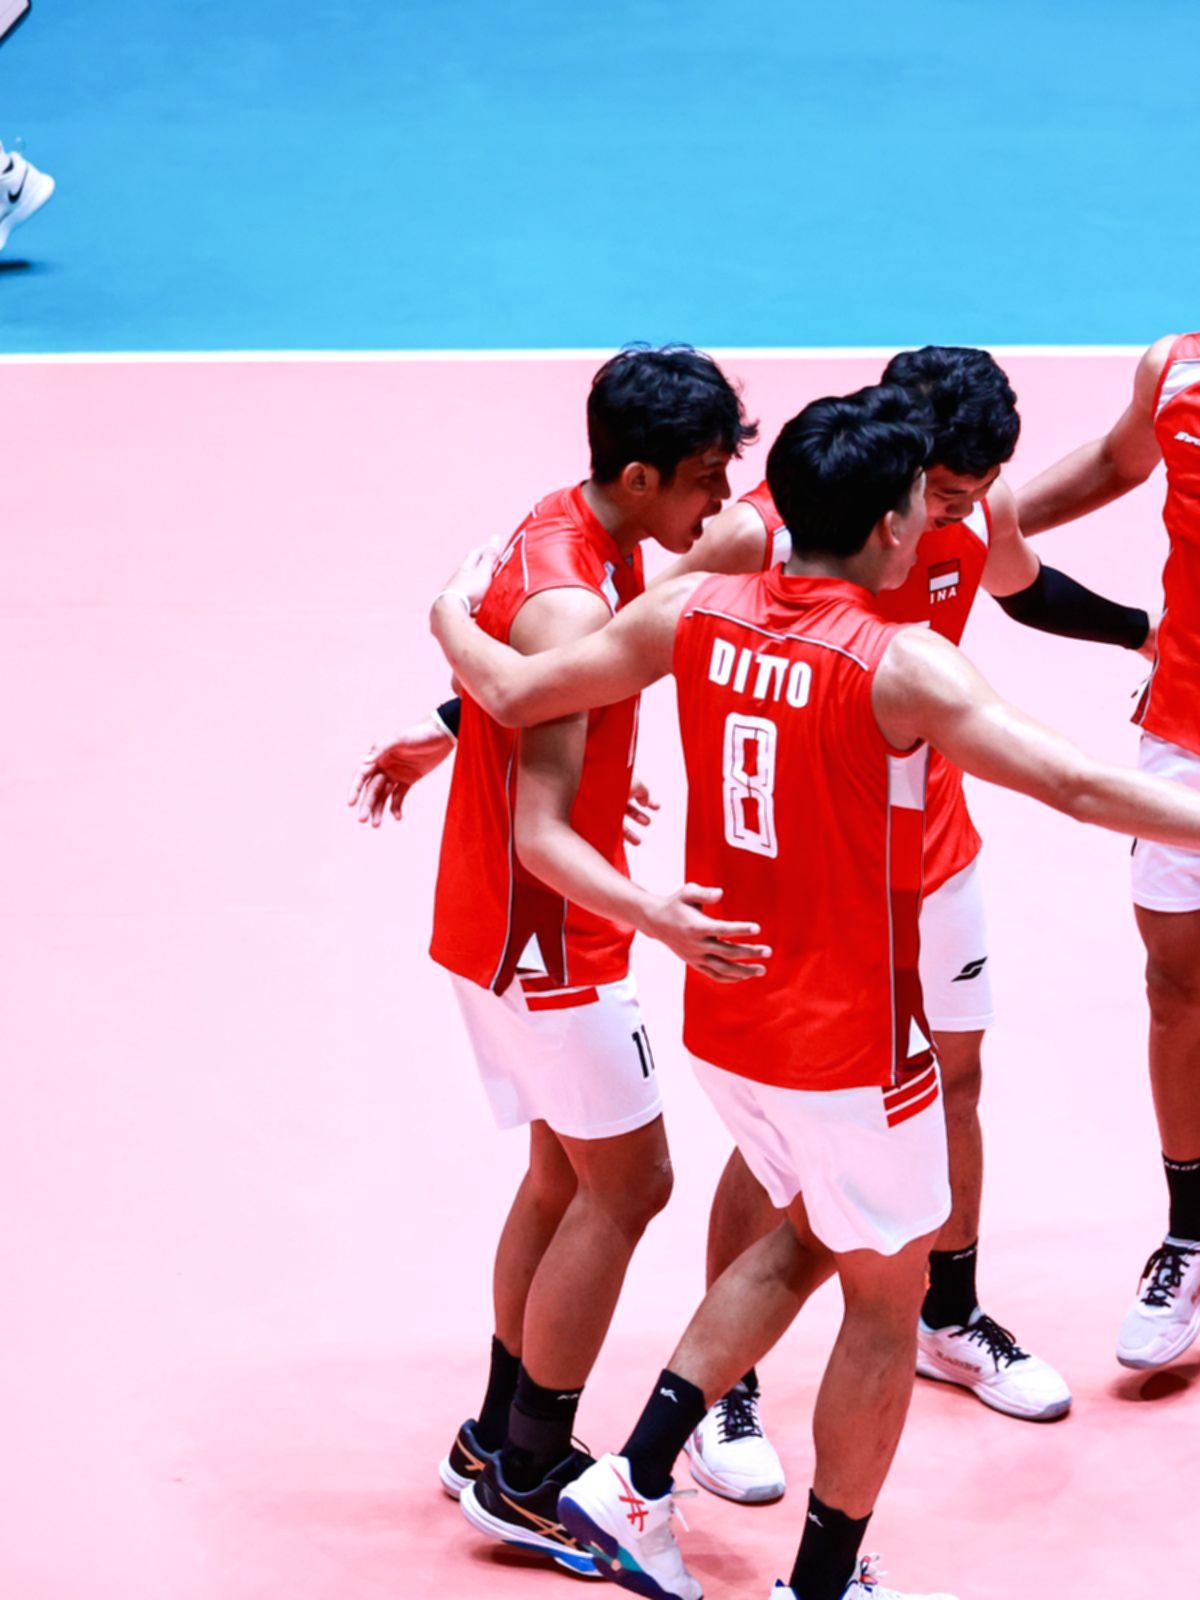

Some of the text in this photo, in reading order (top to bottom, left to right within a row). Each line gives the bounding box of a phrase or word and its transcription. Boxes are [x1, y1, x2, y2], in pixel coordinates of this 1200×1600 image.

[929, 587, 957, 604] INA
[708, 637, 812, 708] DITTO
[722, 711, 778, 859] 8
